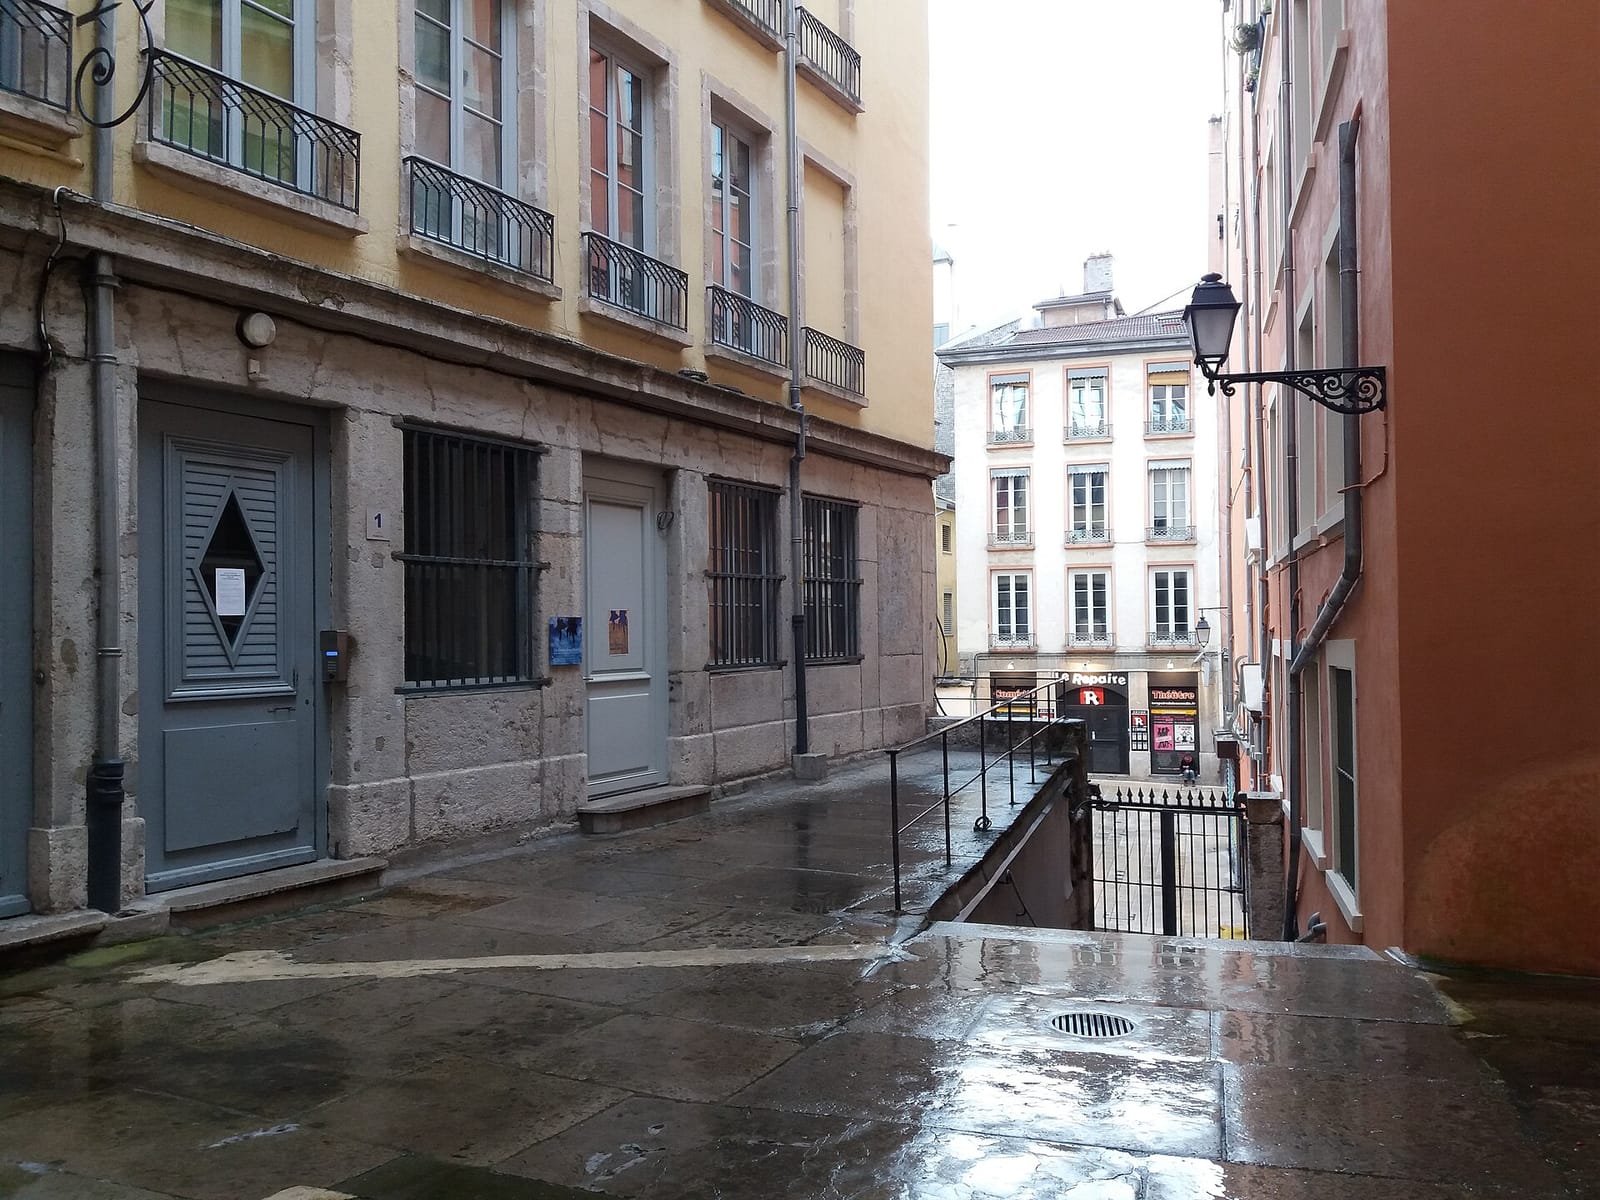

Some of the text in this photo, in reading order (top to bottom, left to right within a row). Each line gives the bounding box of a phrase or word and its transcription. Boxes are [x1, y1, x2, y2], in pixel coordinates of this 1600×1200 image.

[374, 512, 382, 529] 1
[1072, 673, 1127, 686] Repaire
[1083, 690, 1100, 706] R
[1151, 690, 1195, 700] Théâtre
